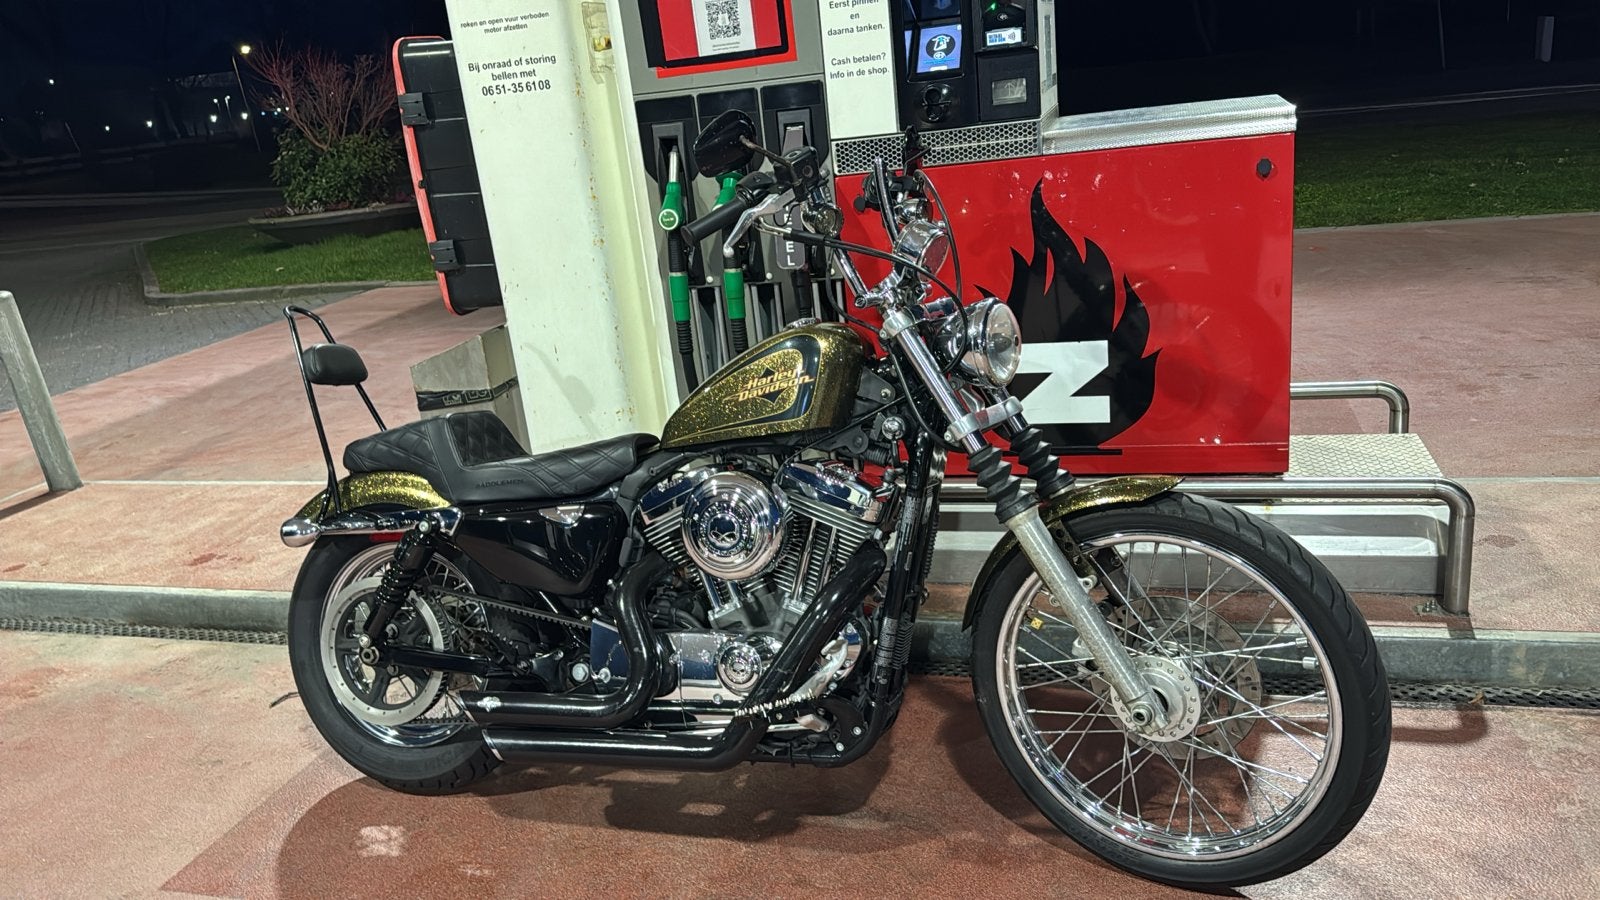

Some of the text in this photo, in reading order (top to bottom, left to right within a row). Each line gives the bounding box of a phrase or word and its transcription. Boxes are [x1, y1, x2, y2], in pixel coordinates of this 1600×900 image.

[829, 0, 850, 9] Eerst
[488, 17, 503, 25] open
[520, 12, 549, 20] verboden
[850, 12, 860, 20] en
[503, 23, 528, 32] afzetten
[827, 23, 885, 36] daarna tanken.
[468, 54, 557, 73] Bij onraad of storing
[831, 52, 886, 66] Cash betalen?
[491, 68, 537, 81] bellen met
[830, 71, 845, 79] Info
[856, 68, 866, 76] de
[868, 67, 890, 75] shop.
